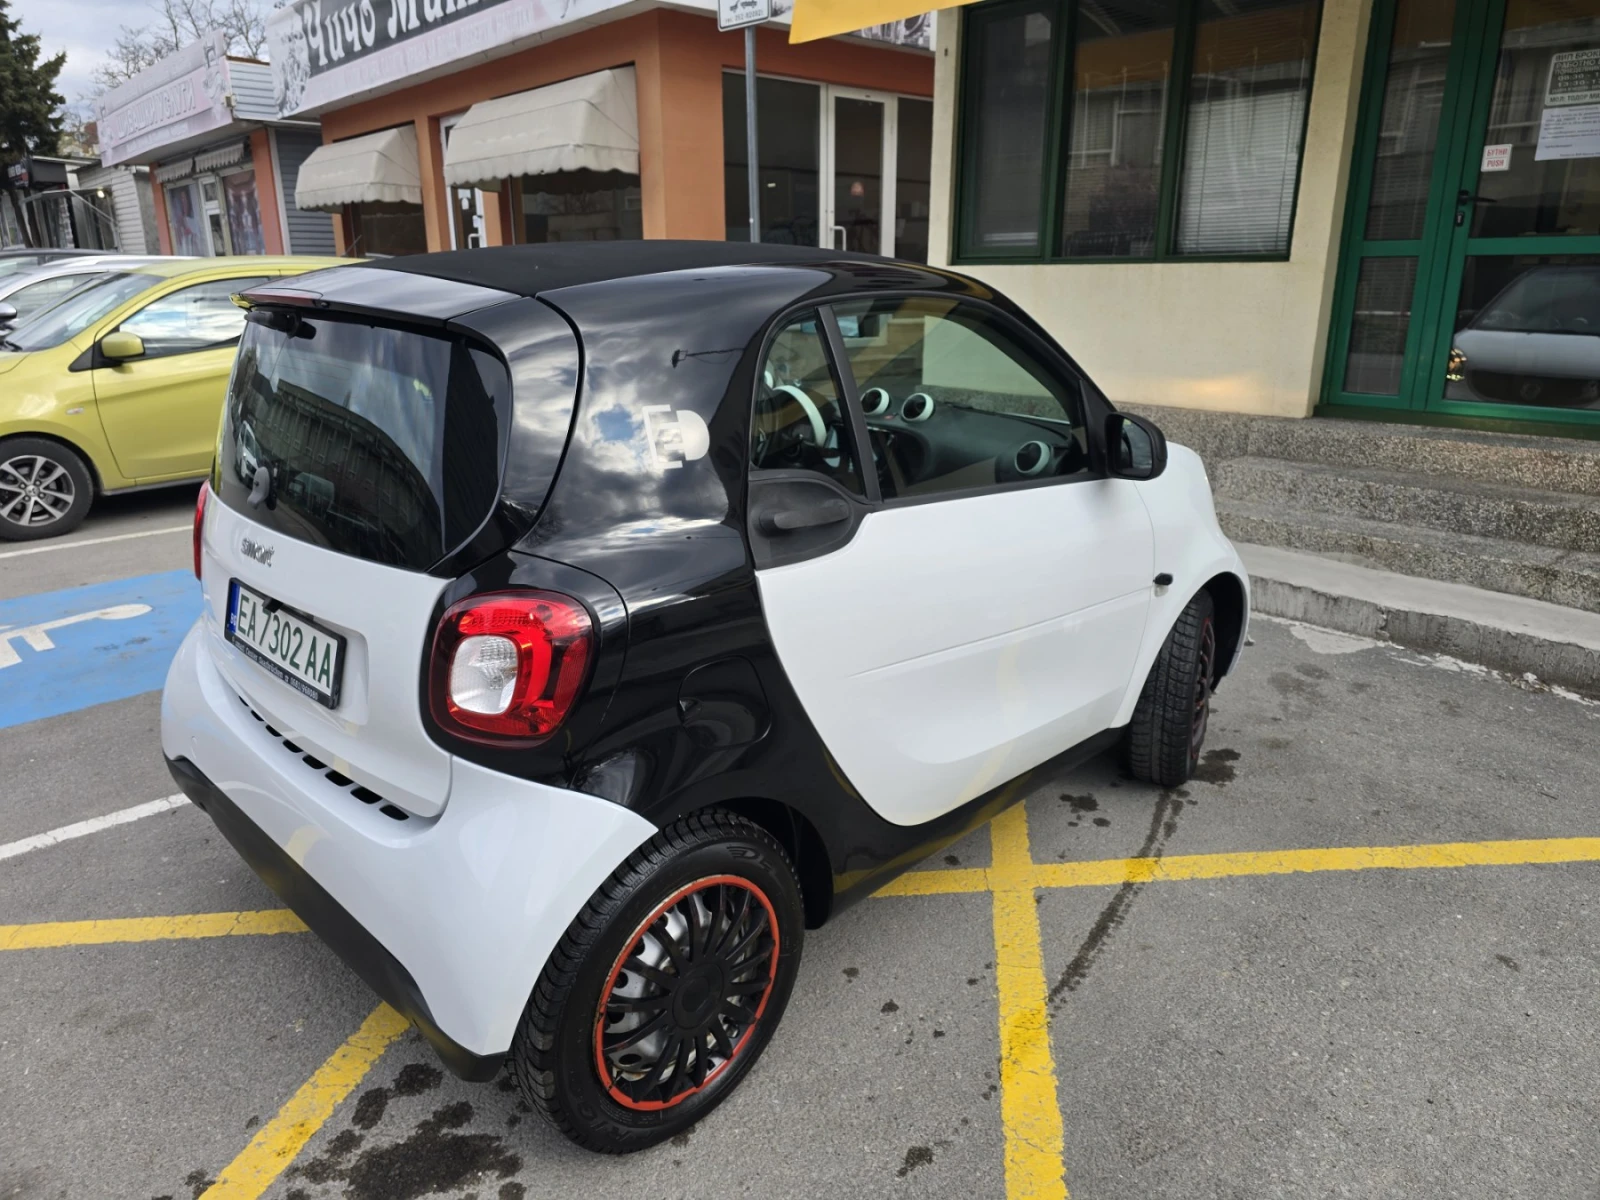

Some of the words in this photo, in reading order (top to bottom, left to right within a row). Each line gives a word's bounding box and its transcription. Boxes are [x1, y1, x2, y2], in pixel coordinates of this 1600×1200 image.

[302, 0, 374, 66] Чичо
[1556, 60, 1596, 70] РАБОТНО
[1487, 159, 1505, 167] PUSH
[241, 538, 275, 567] smart
[259, 607, 304, 671] 7302
